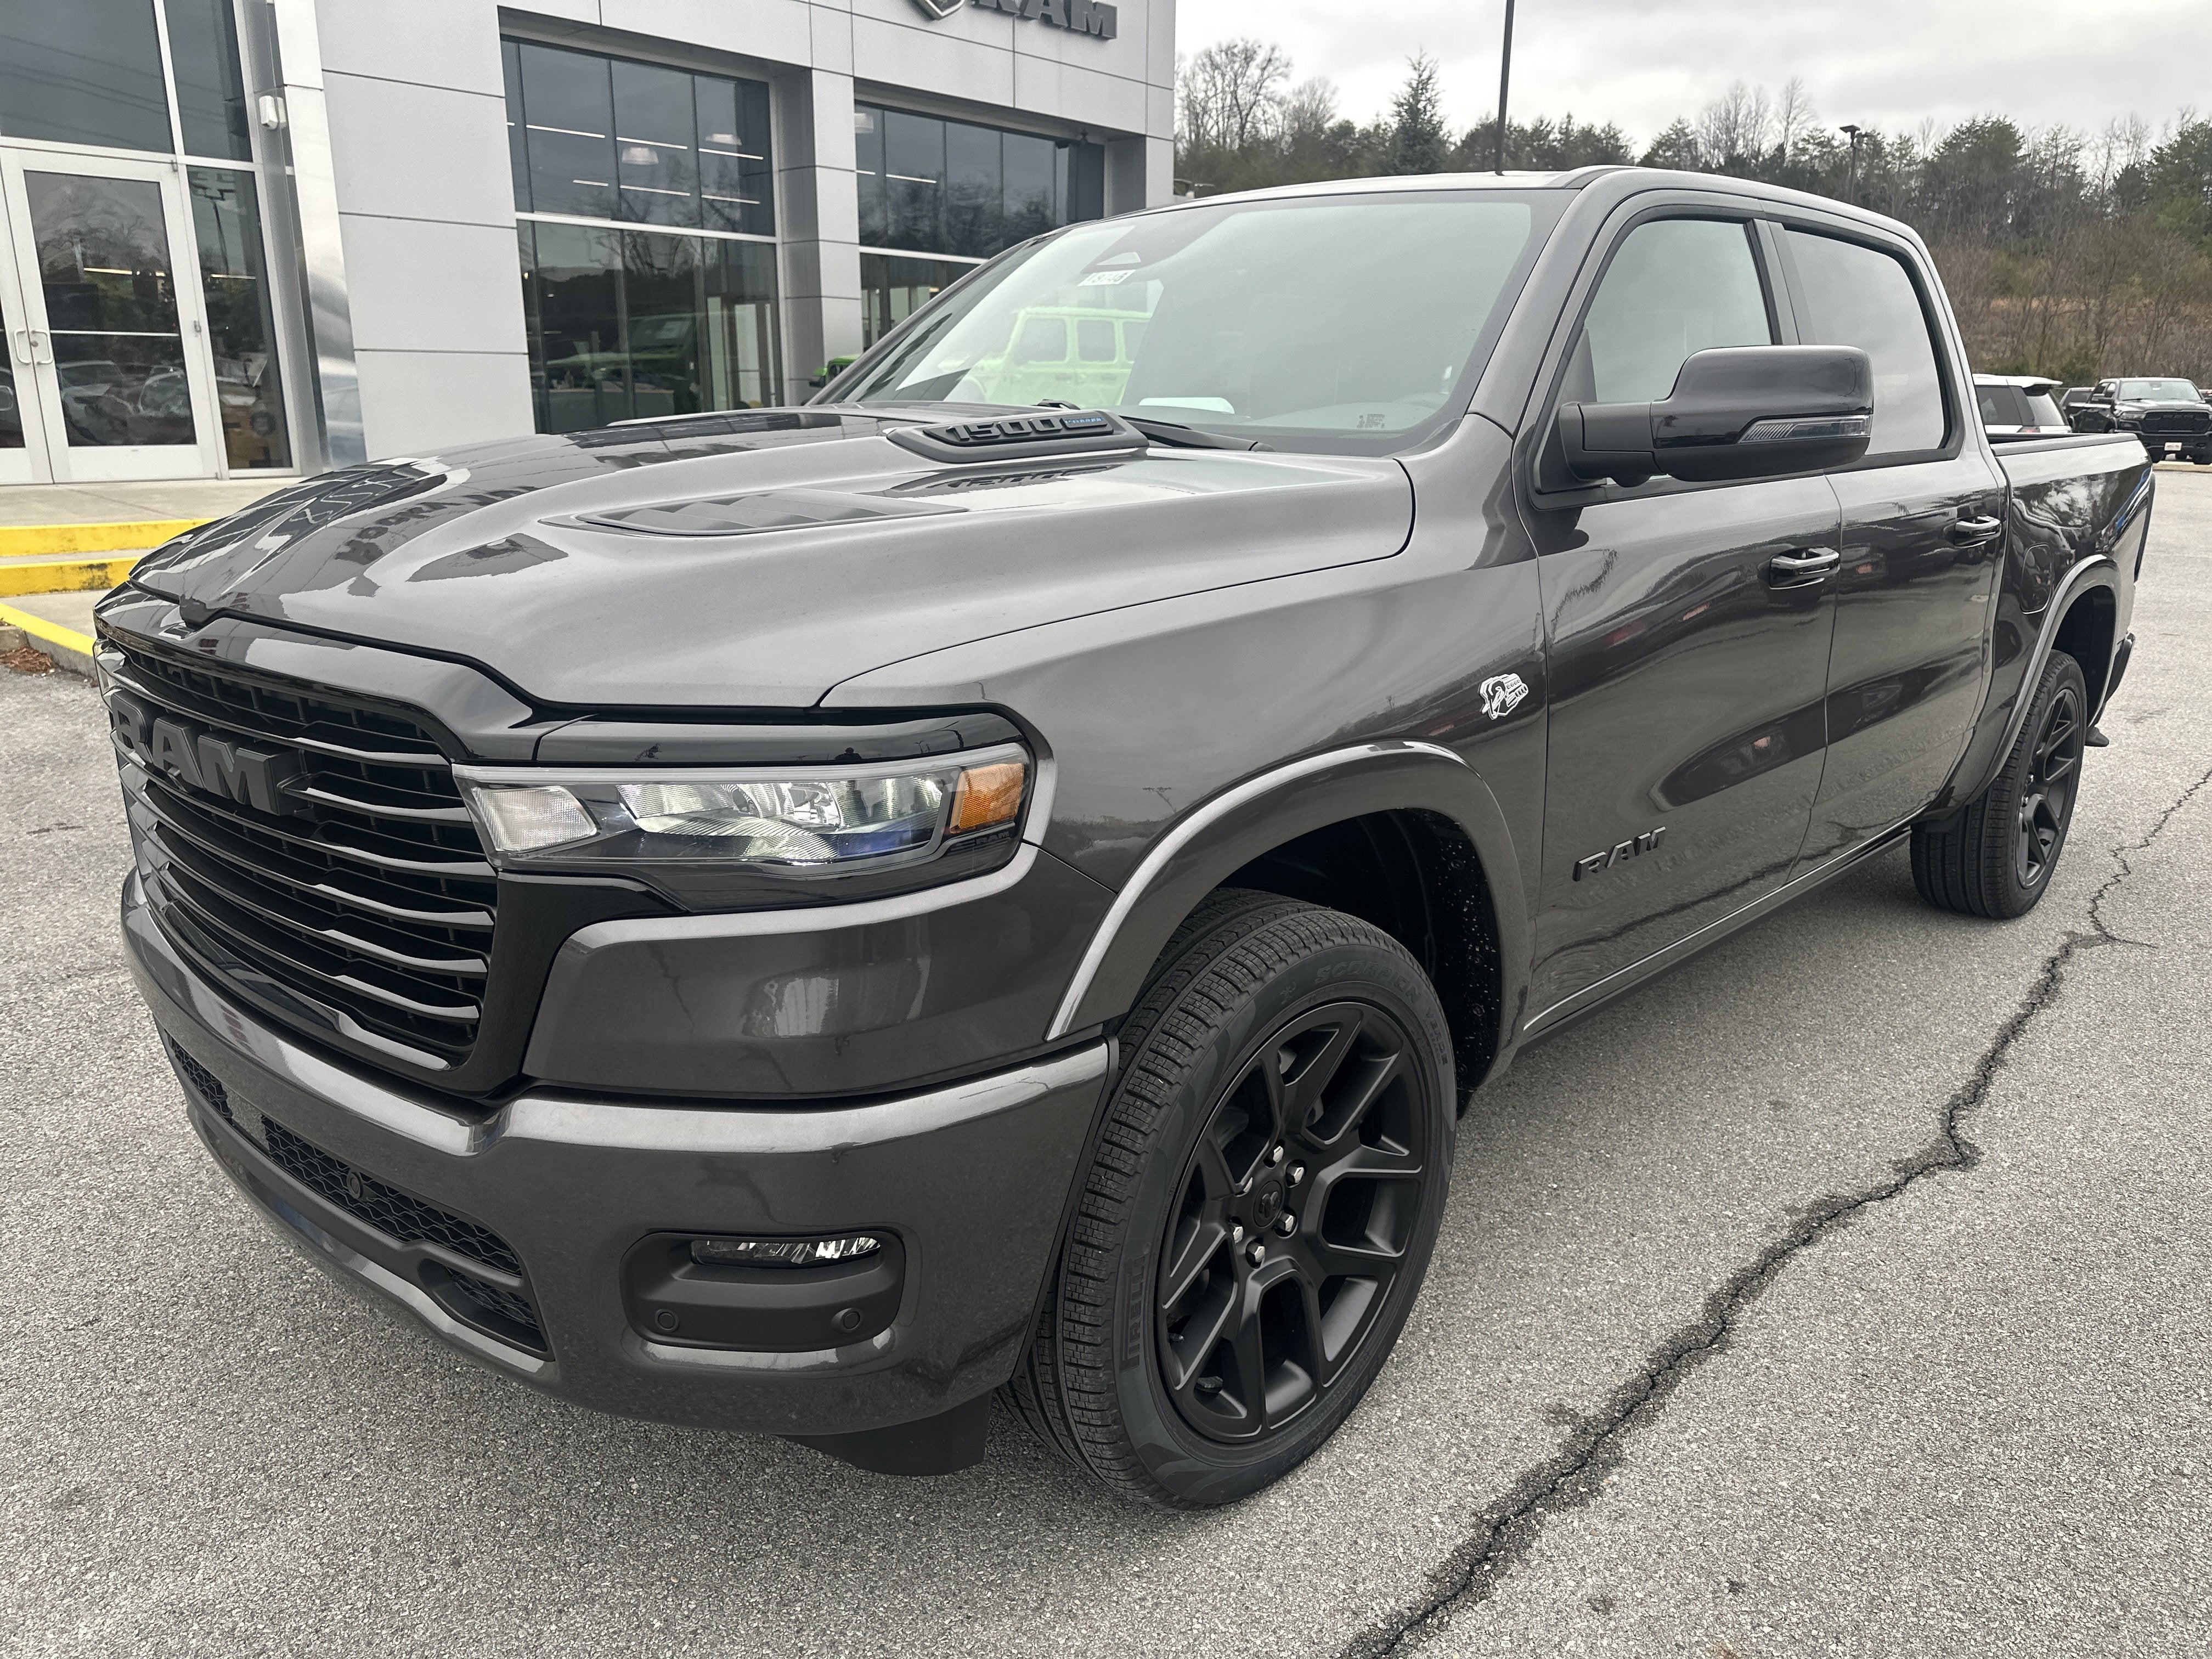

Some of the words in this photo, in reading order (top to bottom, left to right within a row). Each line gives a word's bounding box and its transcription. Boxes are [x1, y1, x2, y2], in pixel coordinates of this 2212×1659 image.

[946, 417, 1062, 441] 1500
[111, 689, 281, 816] RAM
[977, 831, 1009, 844] RAM
[1572, 826, 1666, 882] RAM
[1314, 960, 1419, 1003] SCORPION
[1119, 1255, 1146, 1372] PIRELLI
